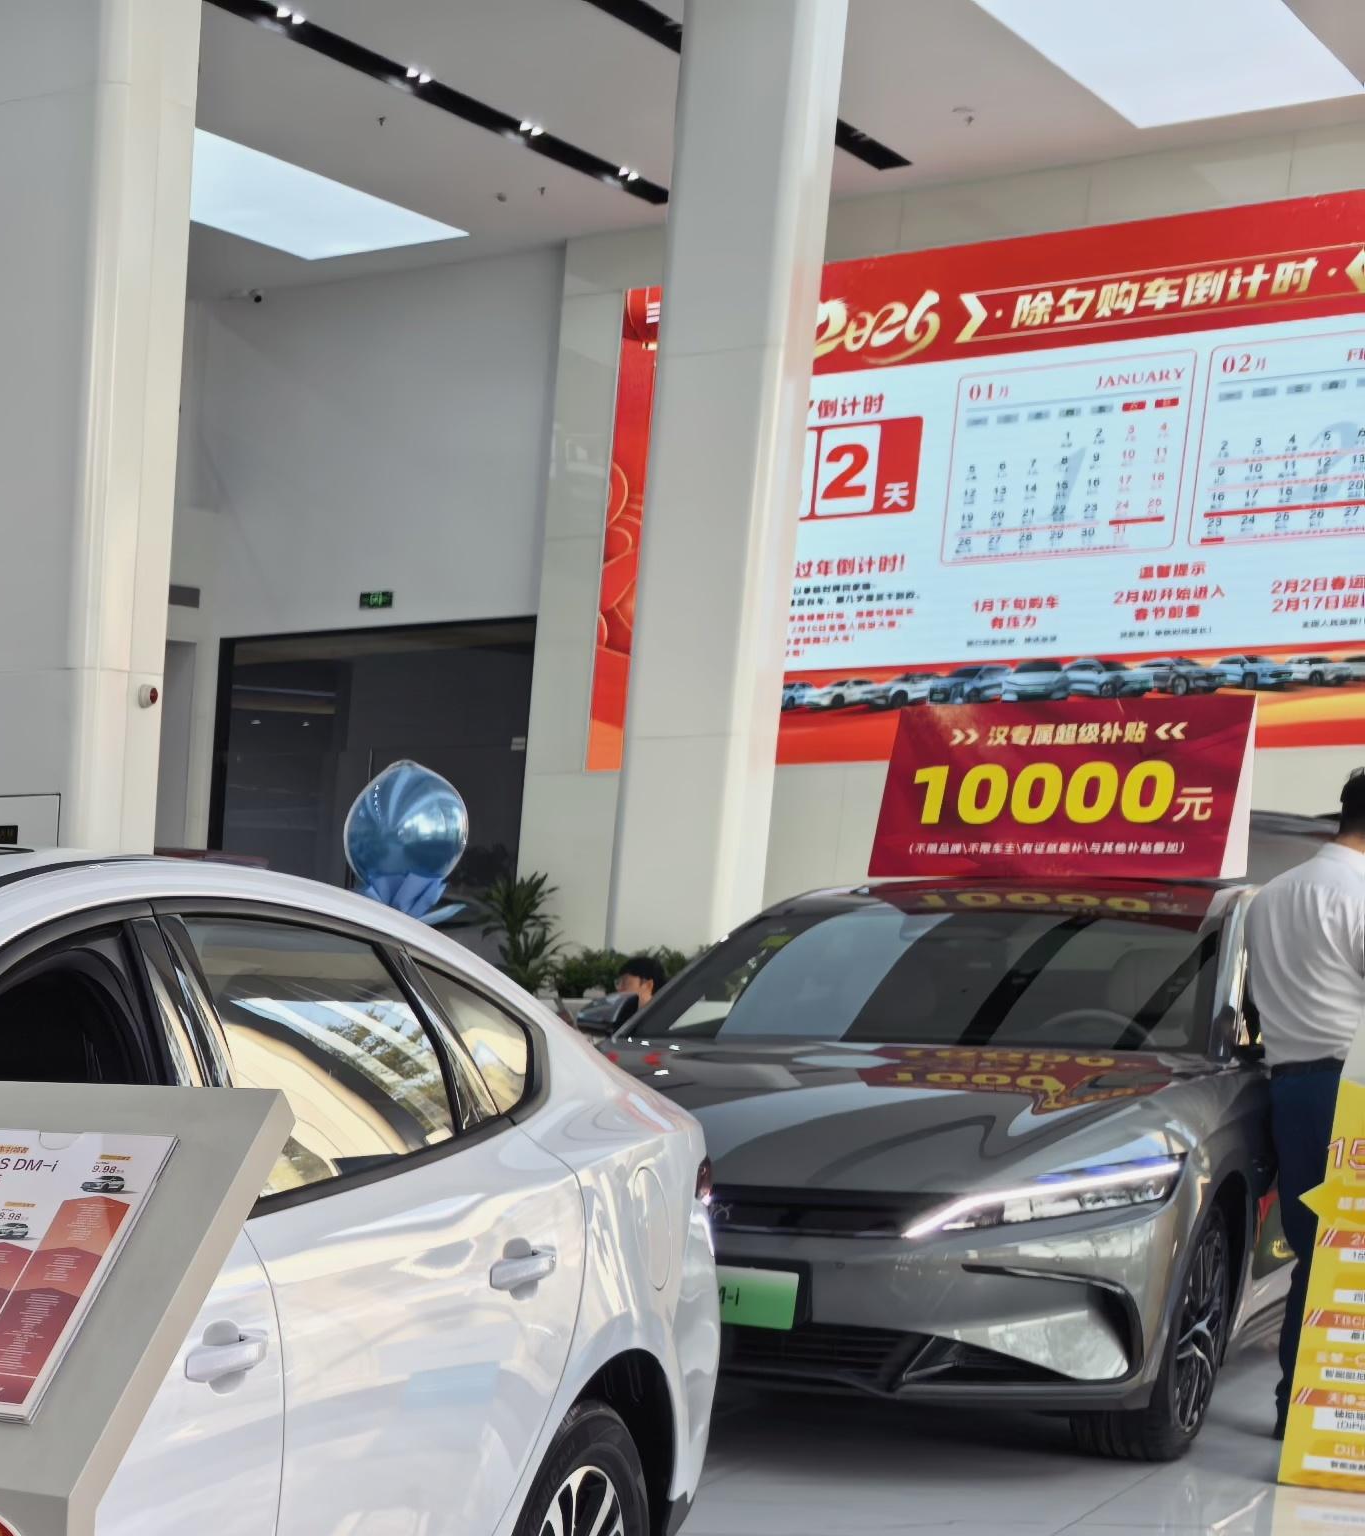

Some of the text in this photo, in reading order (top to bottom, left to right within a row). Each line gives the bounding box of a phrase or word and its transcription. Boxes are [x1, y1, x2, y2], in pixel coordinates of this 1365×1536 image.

[1010, 257, 1318, 328] 除夕购车倒计时
[1096, 367, 1186, 390] JANUARY
[809, 393, 885, 419] 倒计时
[821, 444, 909, 509] 2 天
[987, 721, 1149, 747] 汉专属超级补贴
[13, 1158, 60, 1173] DM-i
[91, 1165, 117, 1174] 9.98
